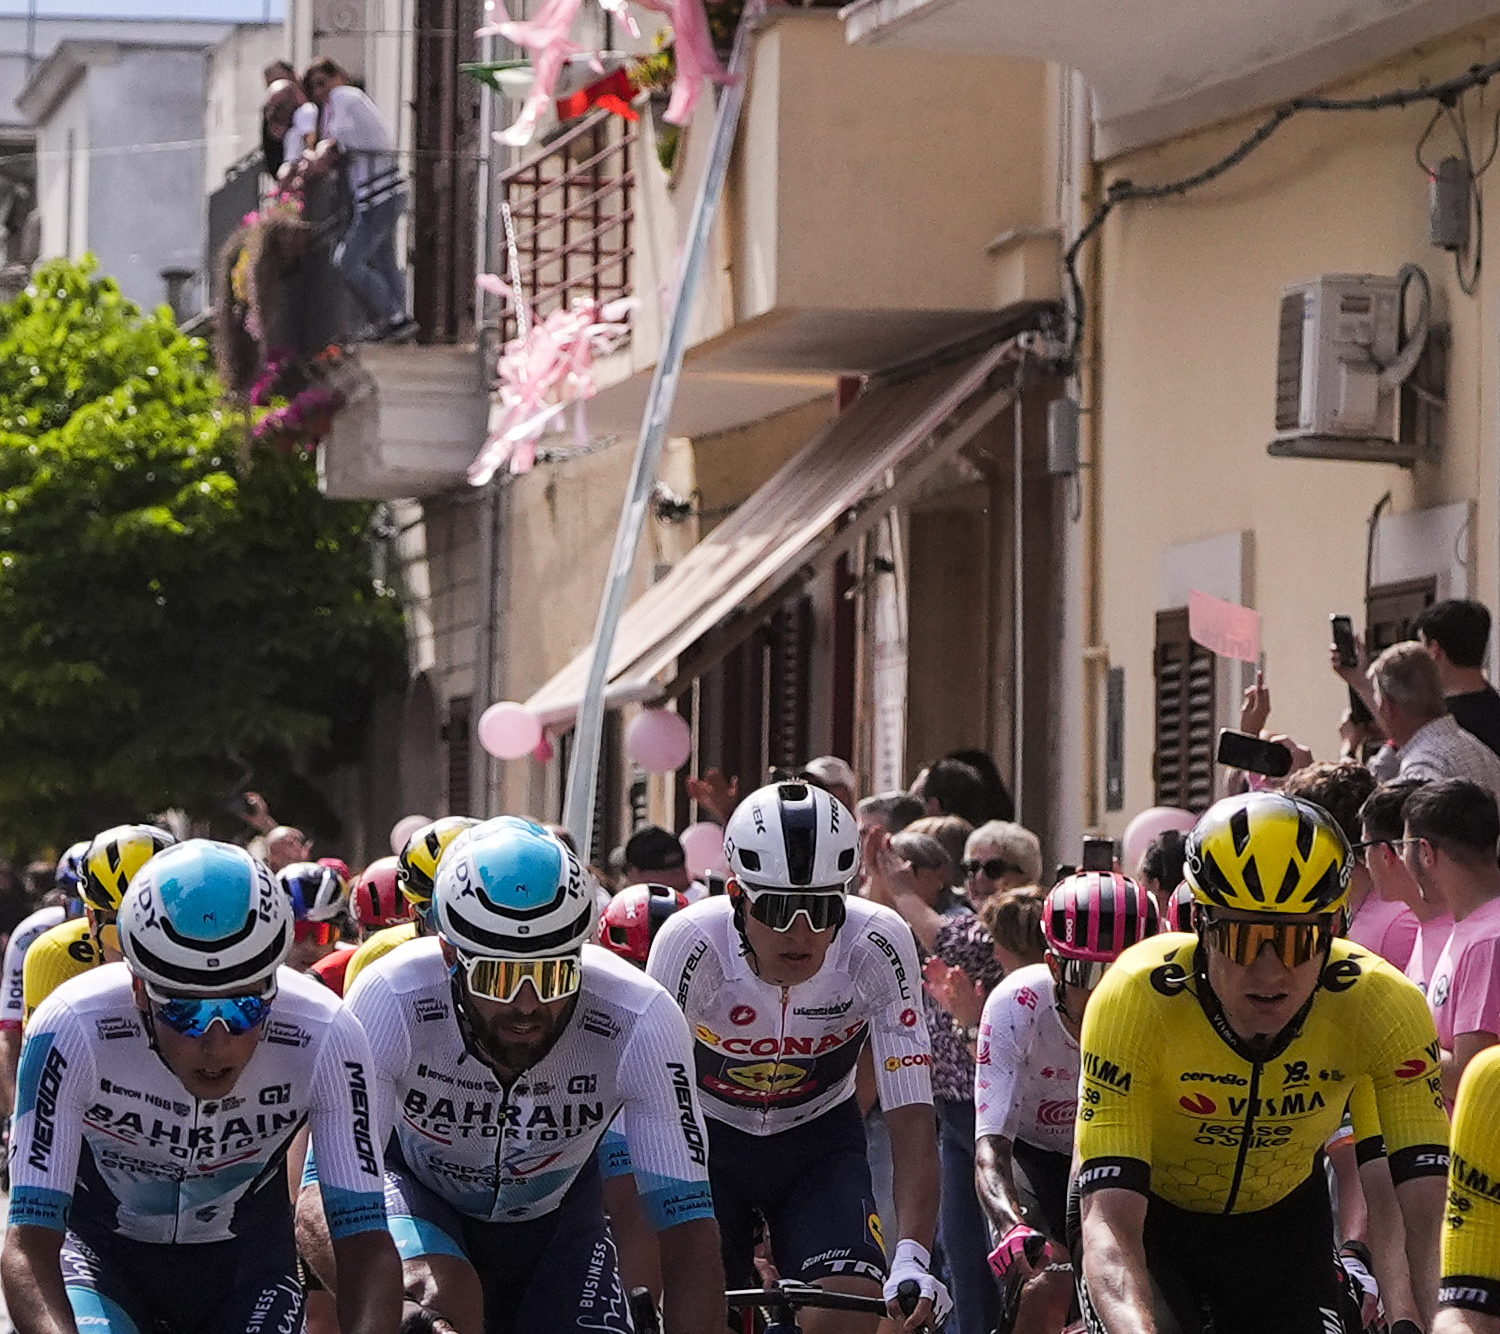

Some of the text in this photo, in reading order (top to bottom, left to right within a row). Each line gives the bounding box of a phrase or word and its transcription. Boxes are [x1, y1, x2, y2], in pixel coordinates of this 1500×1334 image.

[265, 1020, 313, 1047] friendly
[29, 1045, 68, 1173] MERIDA
[144, 1093, 173, 1111] NBB
[404, 1088, 605, 1129] BAHRAIN
[665, 1061, 707, 1168] MERIDA
[1228, 1091, 1327, 1118] VISMA
[85, 1103, 298, 1148] BAHRAIN
[344, 1060, 380, 1178] MERIDA
[1198, 1121, 1295, 1138] lease
[1415, 1152, 1451, 1169] SR
[25, 1208, 59, 1221] Bank
[801, 1247, 853, 1273] Santini
[578, 1241, 607, 1309] BUSINESS
